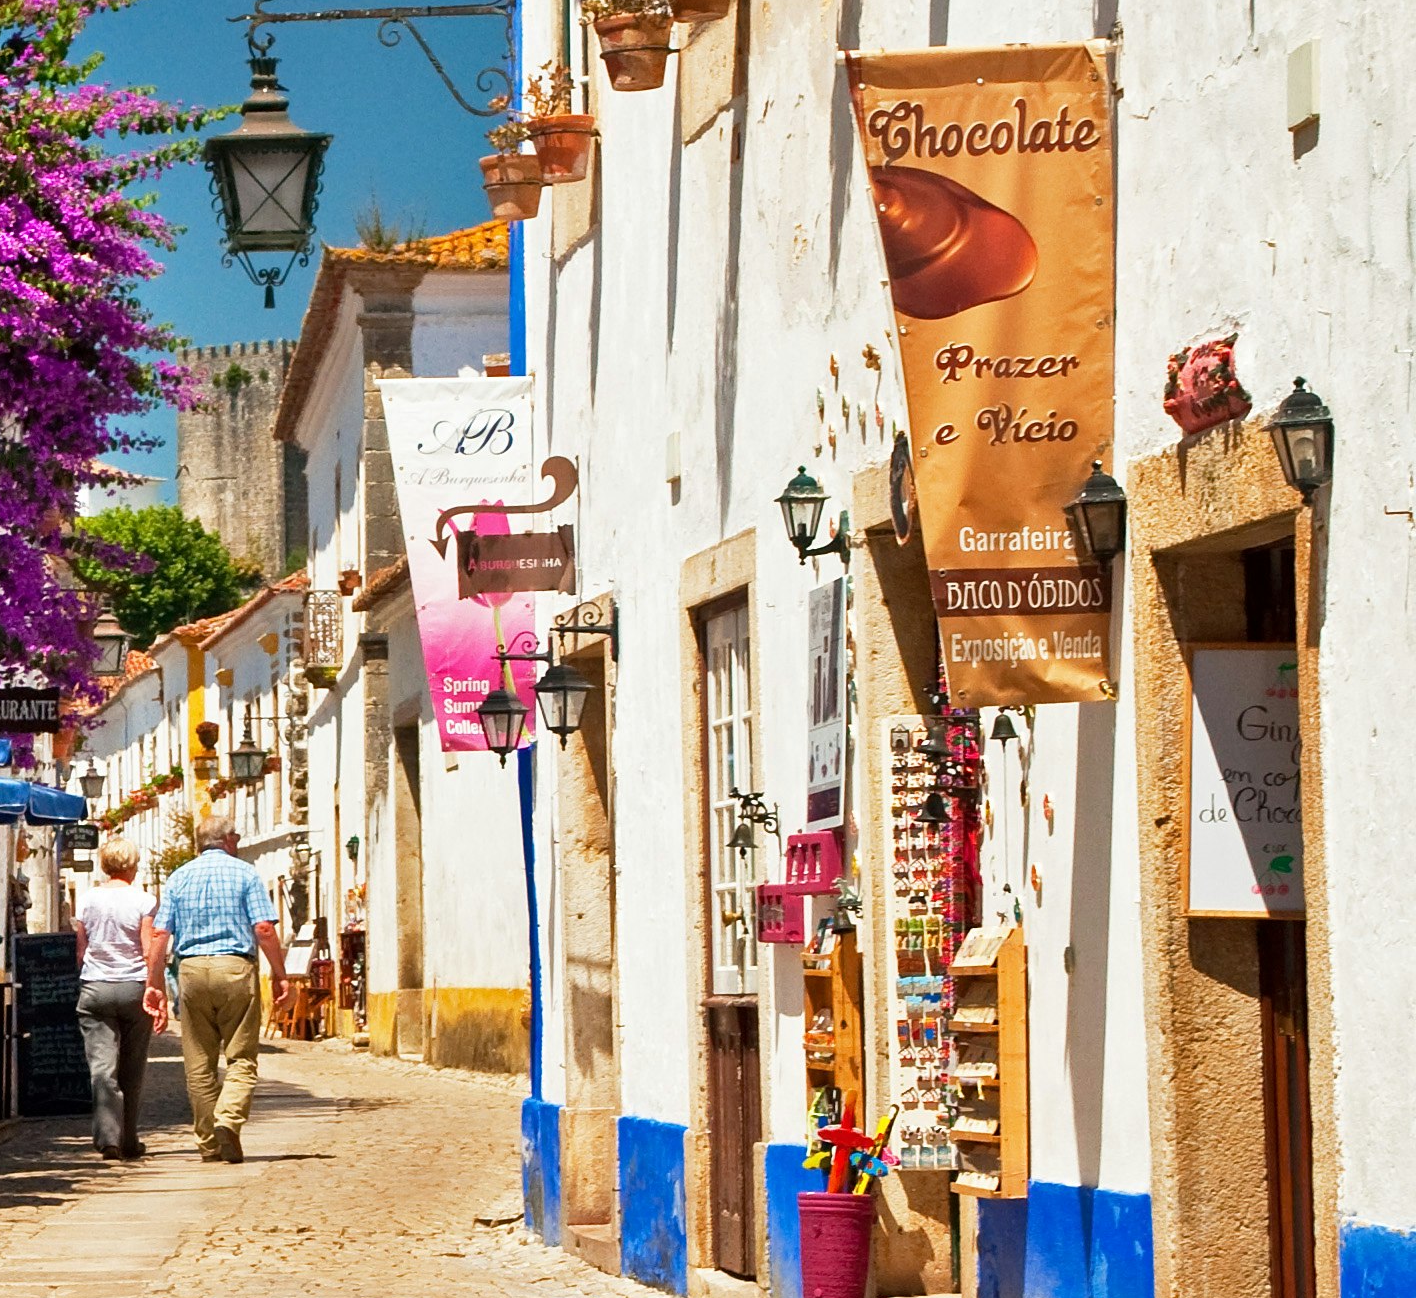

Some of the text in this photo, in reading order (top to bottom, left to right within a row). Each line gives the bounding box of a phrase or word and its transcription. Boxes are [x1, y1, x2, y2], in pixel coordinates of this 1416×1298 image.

[869, 98, 1101, 168] Chocolate
[936, 343, 1080, 384] Prazer
[935, 403, 1079, 447] e Vício
[959, 526, 1076, 552] Garrafeira
[946, 573, 1104, 610] BACO D'ÓBIDOS
[951, 629, 1103, 668] Exposição e Venda
[443, 677, 490, 696] Spring
[1220, 768, 1252, 784] em
[1199, 793, 1228, 823] de
